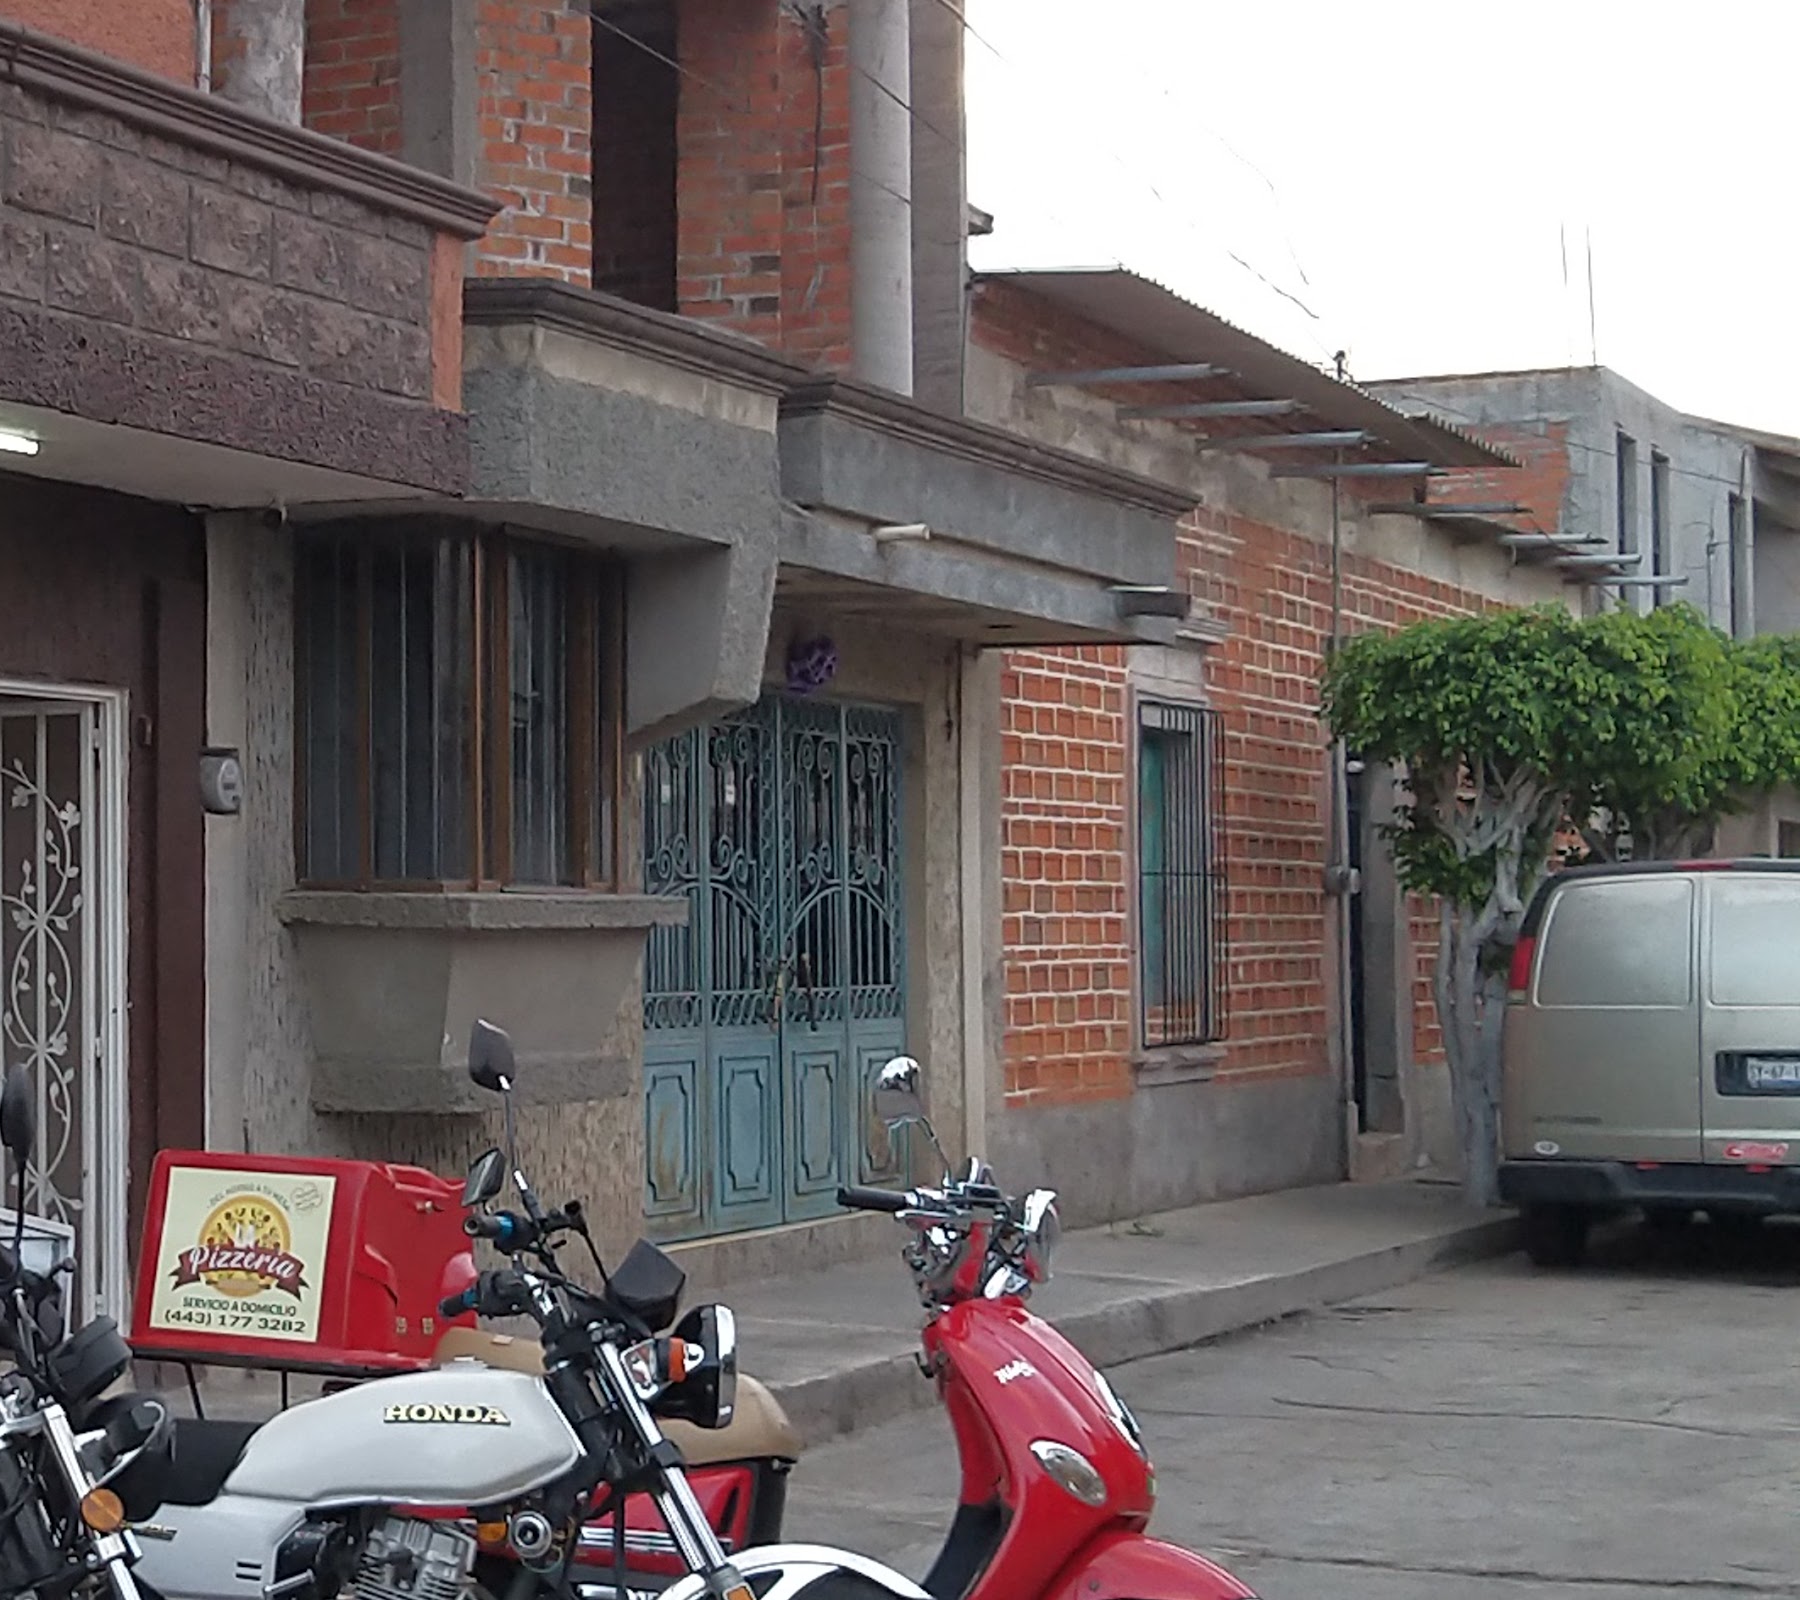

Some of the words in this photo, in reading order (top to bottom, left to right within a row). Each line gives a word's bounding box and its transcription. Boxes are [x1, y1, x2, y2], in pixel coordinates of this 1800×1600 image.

[182, 1296, 229, 1312] SERVICIO
[240, 1301, 296, 1317] DOMICILIO
[165, 1309, 211, 1326] (443)
[218, 1314, 253, 1329] 177
[257, 1318, 306, 1334] 3282
[384, 1404, 511, 1427] HONDA
